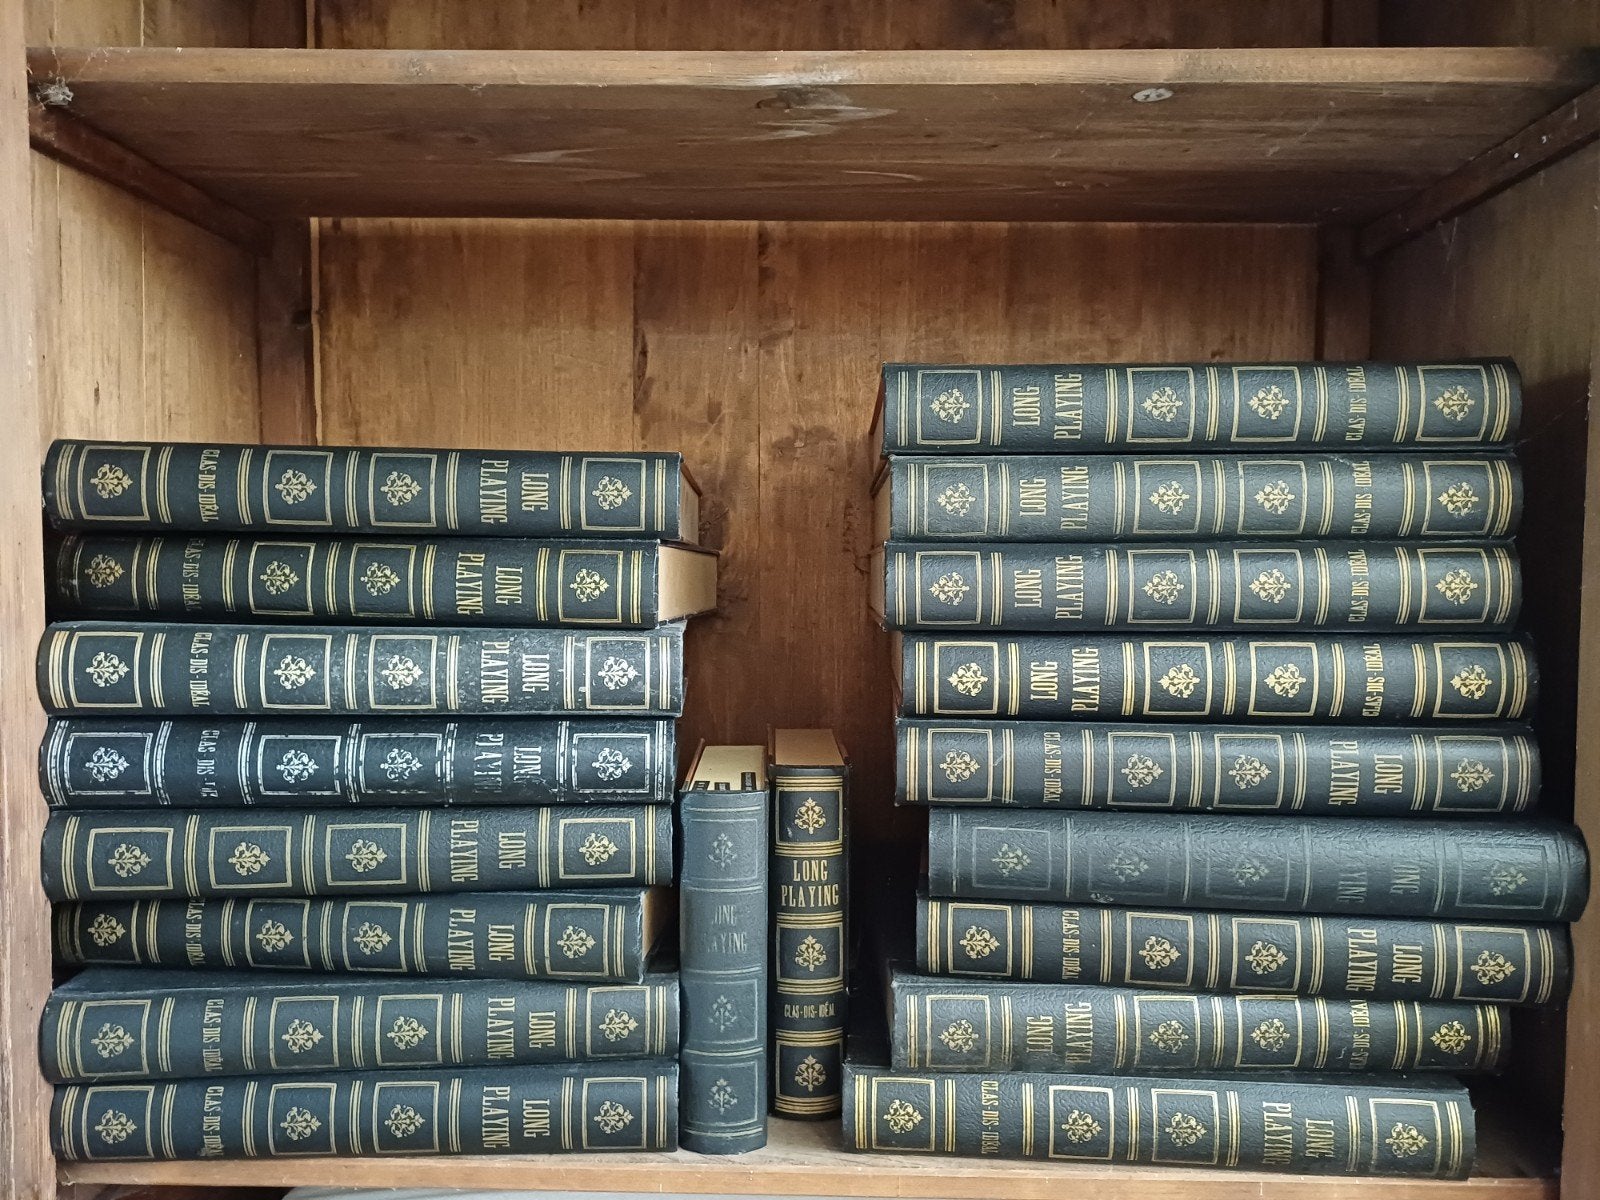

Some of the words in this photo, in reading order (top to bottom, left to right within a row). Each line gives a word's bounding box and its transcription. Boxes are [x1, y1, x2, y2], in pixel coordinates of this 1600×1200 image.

[1013, 386, 1040, 427] LONG
[1054, 374, 1083, 440] PLAYING
[1345, 366, 1367, 441] CLAS-DIS-IDÉAL
[198, 449, 220, 522] CLAS-DIS-IDÉAL
[480, 460, 508, 523] PLAYING
[521, 472, 549, 512] LONG
[1019, 478, 1047, 516] LONG
[1061, 466, 1090, 530] PLAYING
[455, 552, 484, 615] PLAYING
[495, 566, 522, 604] LONG
[1014, 569, 1042, 608] LONG
[1055, 555, 1084, 620] PLAYING
[1347, 549, 1369, 622] CLAS-DIS-IDÉAL
[190, 632, 212, 707] CLAS-DIS-IDÉAL
[480, 641, 509, 704] PLAYING
[522, 653, 550, 692] LONG
[1031, 661, 1058, 701] LONG
[1071, 647, 1100, 712] PLAYING
[1362, 643, 1384, 717] CLAS-DIS-IDÉAL
[1043, 731, 1063, 802] CLAS-DIS-IDÉAL
[1328, 740, 1360, 806] PLAYING
[1373, 754, 1403, 794] LONG
[450, 819, 479, 882] PLAYING
[498, 832, 525, 869] LONG
[793, 860, 827, 881] LONG
[1389, 861, 1420, 895] ONG
[781, 884, 839, 908] PLAYING
[185, 899, 205, 965] LAS-DIS-IDÉAL
[448, 908, 476, 970] PLAYING
[488, 924, 514, 961] LONG
[1060, 910, 1082, 979] CLAS-DIS-IDÉAL
[1345, 928, 1378, 991] PLAYING
[1391, 944, 1423, 983] LONG
[203, 999, 224, 1072] CLAS-DIS-IDÉAL
[487, 997, 514, 1059] PLAYING
[529, 1011, 555, 1048] LONG
[1026, 1015, 1054, 1053] LONG
[1065, 1001, 1093, 1064] PLAYING
[482, 1086, 510, 1148] PLAYING
[522, 1099, 550, 1138] LONG
[981, 1081, 1000, 1154] CLAS-DIS-IDÉAL
[1262, 1101, 1292, 1165] PLAYING
[1305, 1118, 1335, 1158] LONG
